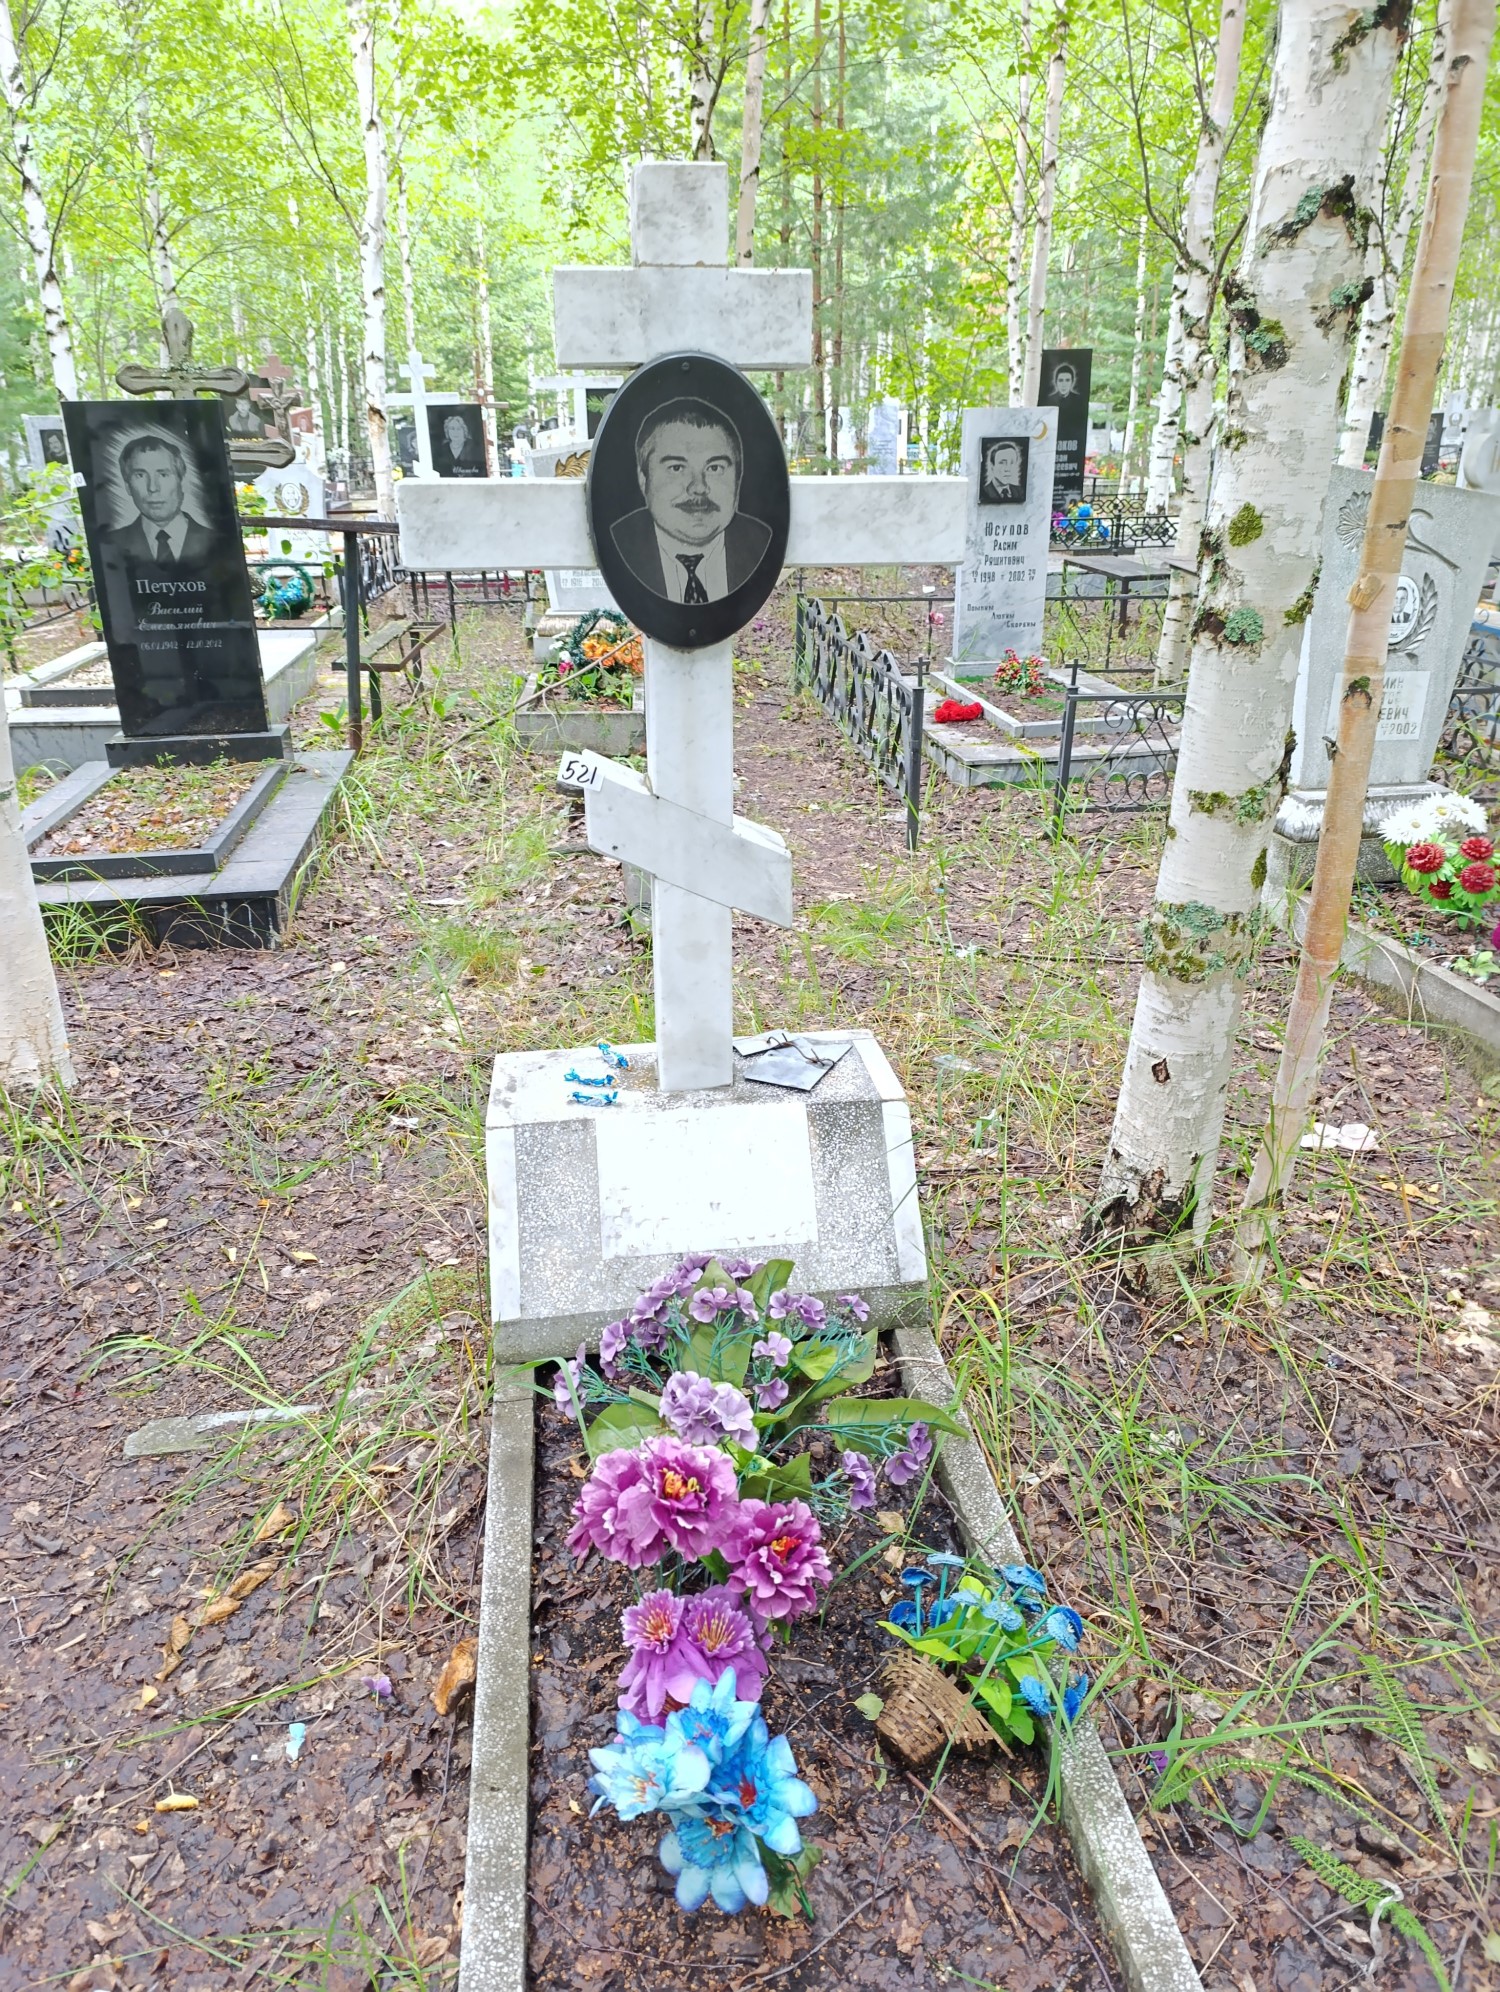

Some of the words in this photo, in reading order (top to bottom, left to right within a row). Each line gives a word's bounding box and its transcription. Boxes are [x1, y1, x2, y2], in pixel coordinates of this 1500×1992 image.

[136, 579, 207, 596] Петухов
[147, 601, 205, 615] Василий
[561, 760, 598, 785] 521
